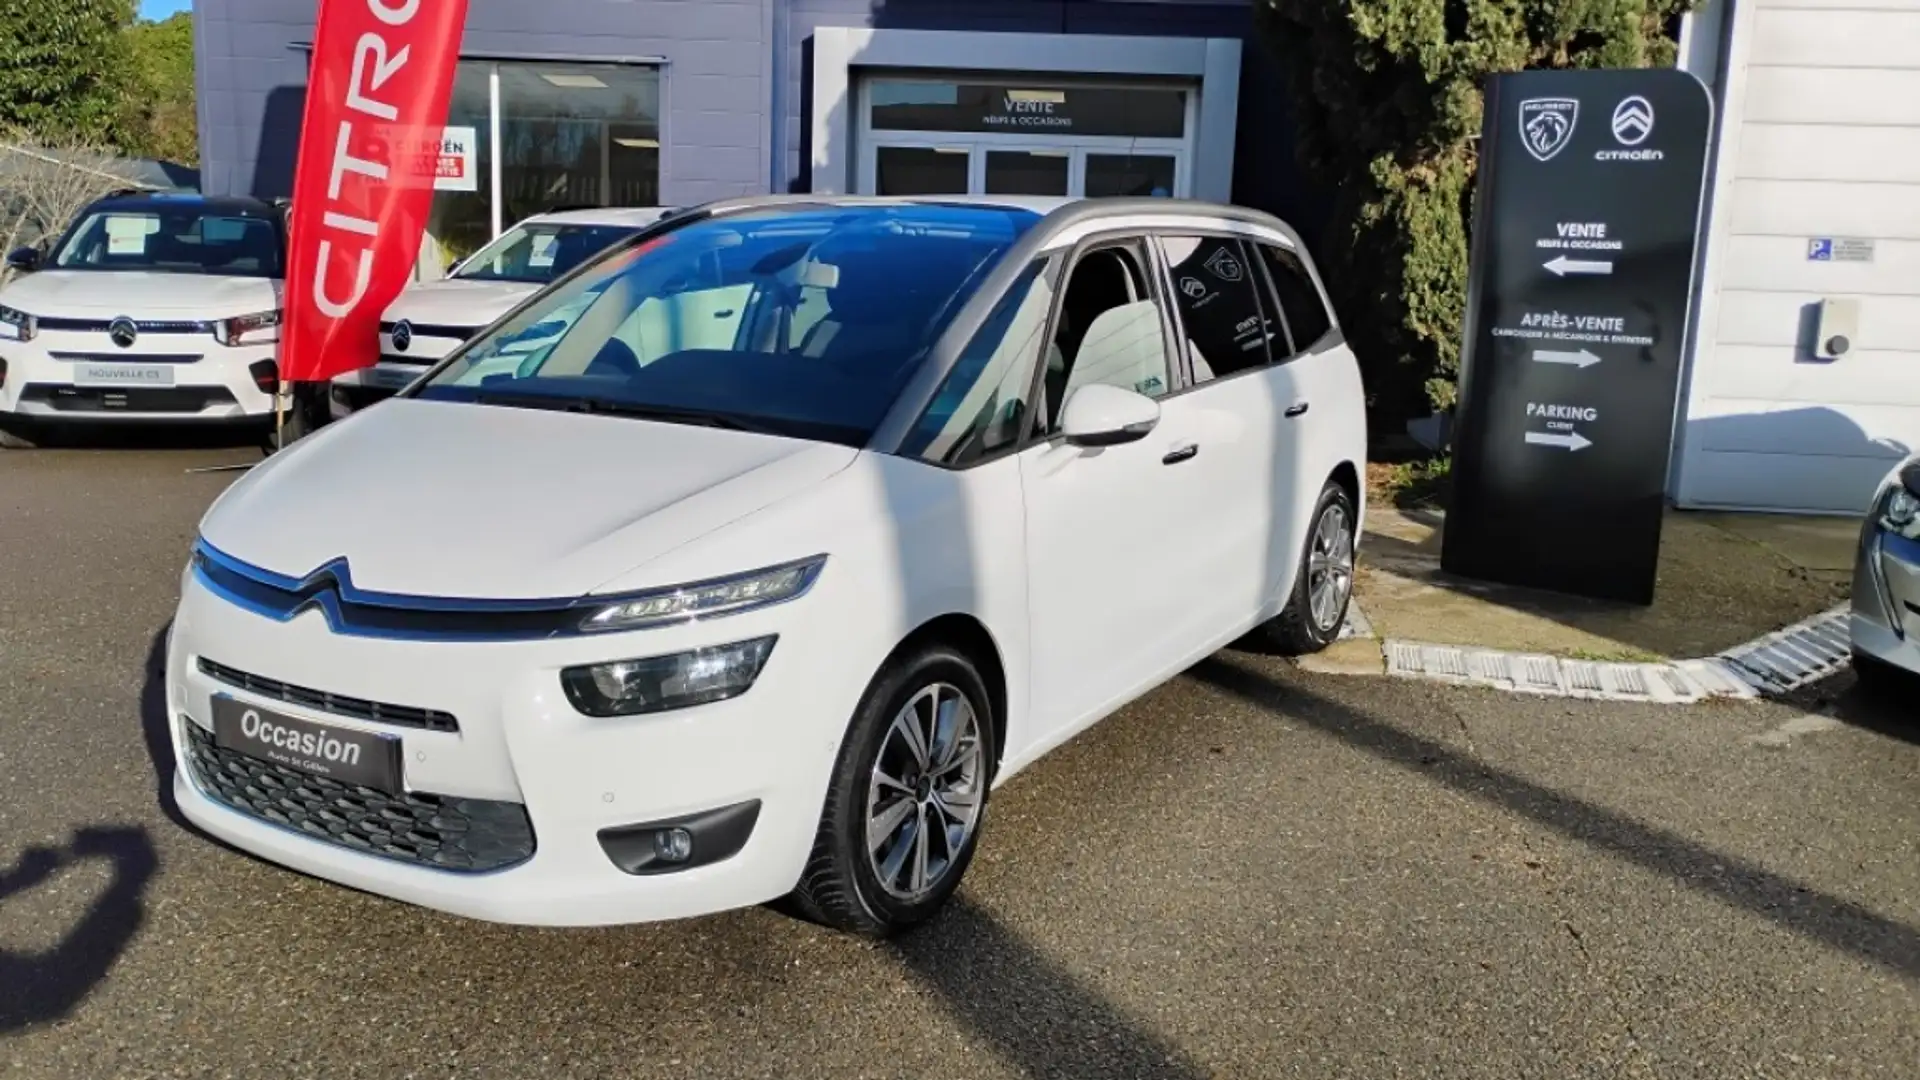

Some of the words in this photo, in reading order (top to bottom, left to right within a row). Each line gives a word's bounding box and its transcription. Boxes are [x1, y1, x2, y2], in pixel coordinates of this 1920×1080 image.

[1003, 97, 1054, 113] VENTE
[1594, 149, 1664, 160] CITROËN
[1556, 222, 1606, 238] VENTE
[1570, 240, 1623, 250] OCCASIONS
[1520, 310, 1625, 332] APRÈS-VENTE
[88, 369, 142, 378] NOUVELLE
[1526, 402, 1598, 421] PARKING
[241, 709, 361, 765] Occasion
